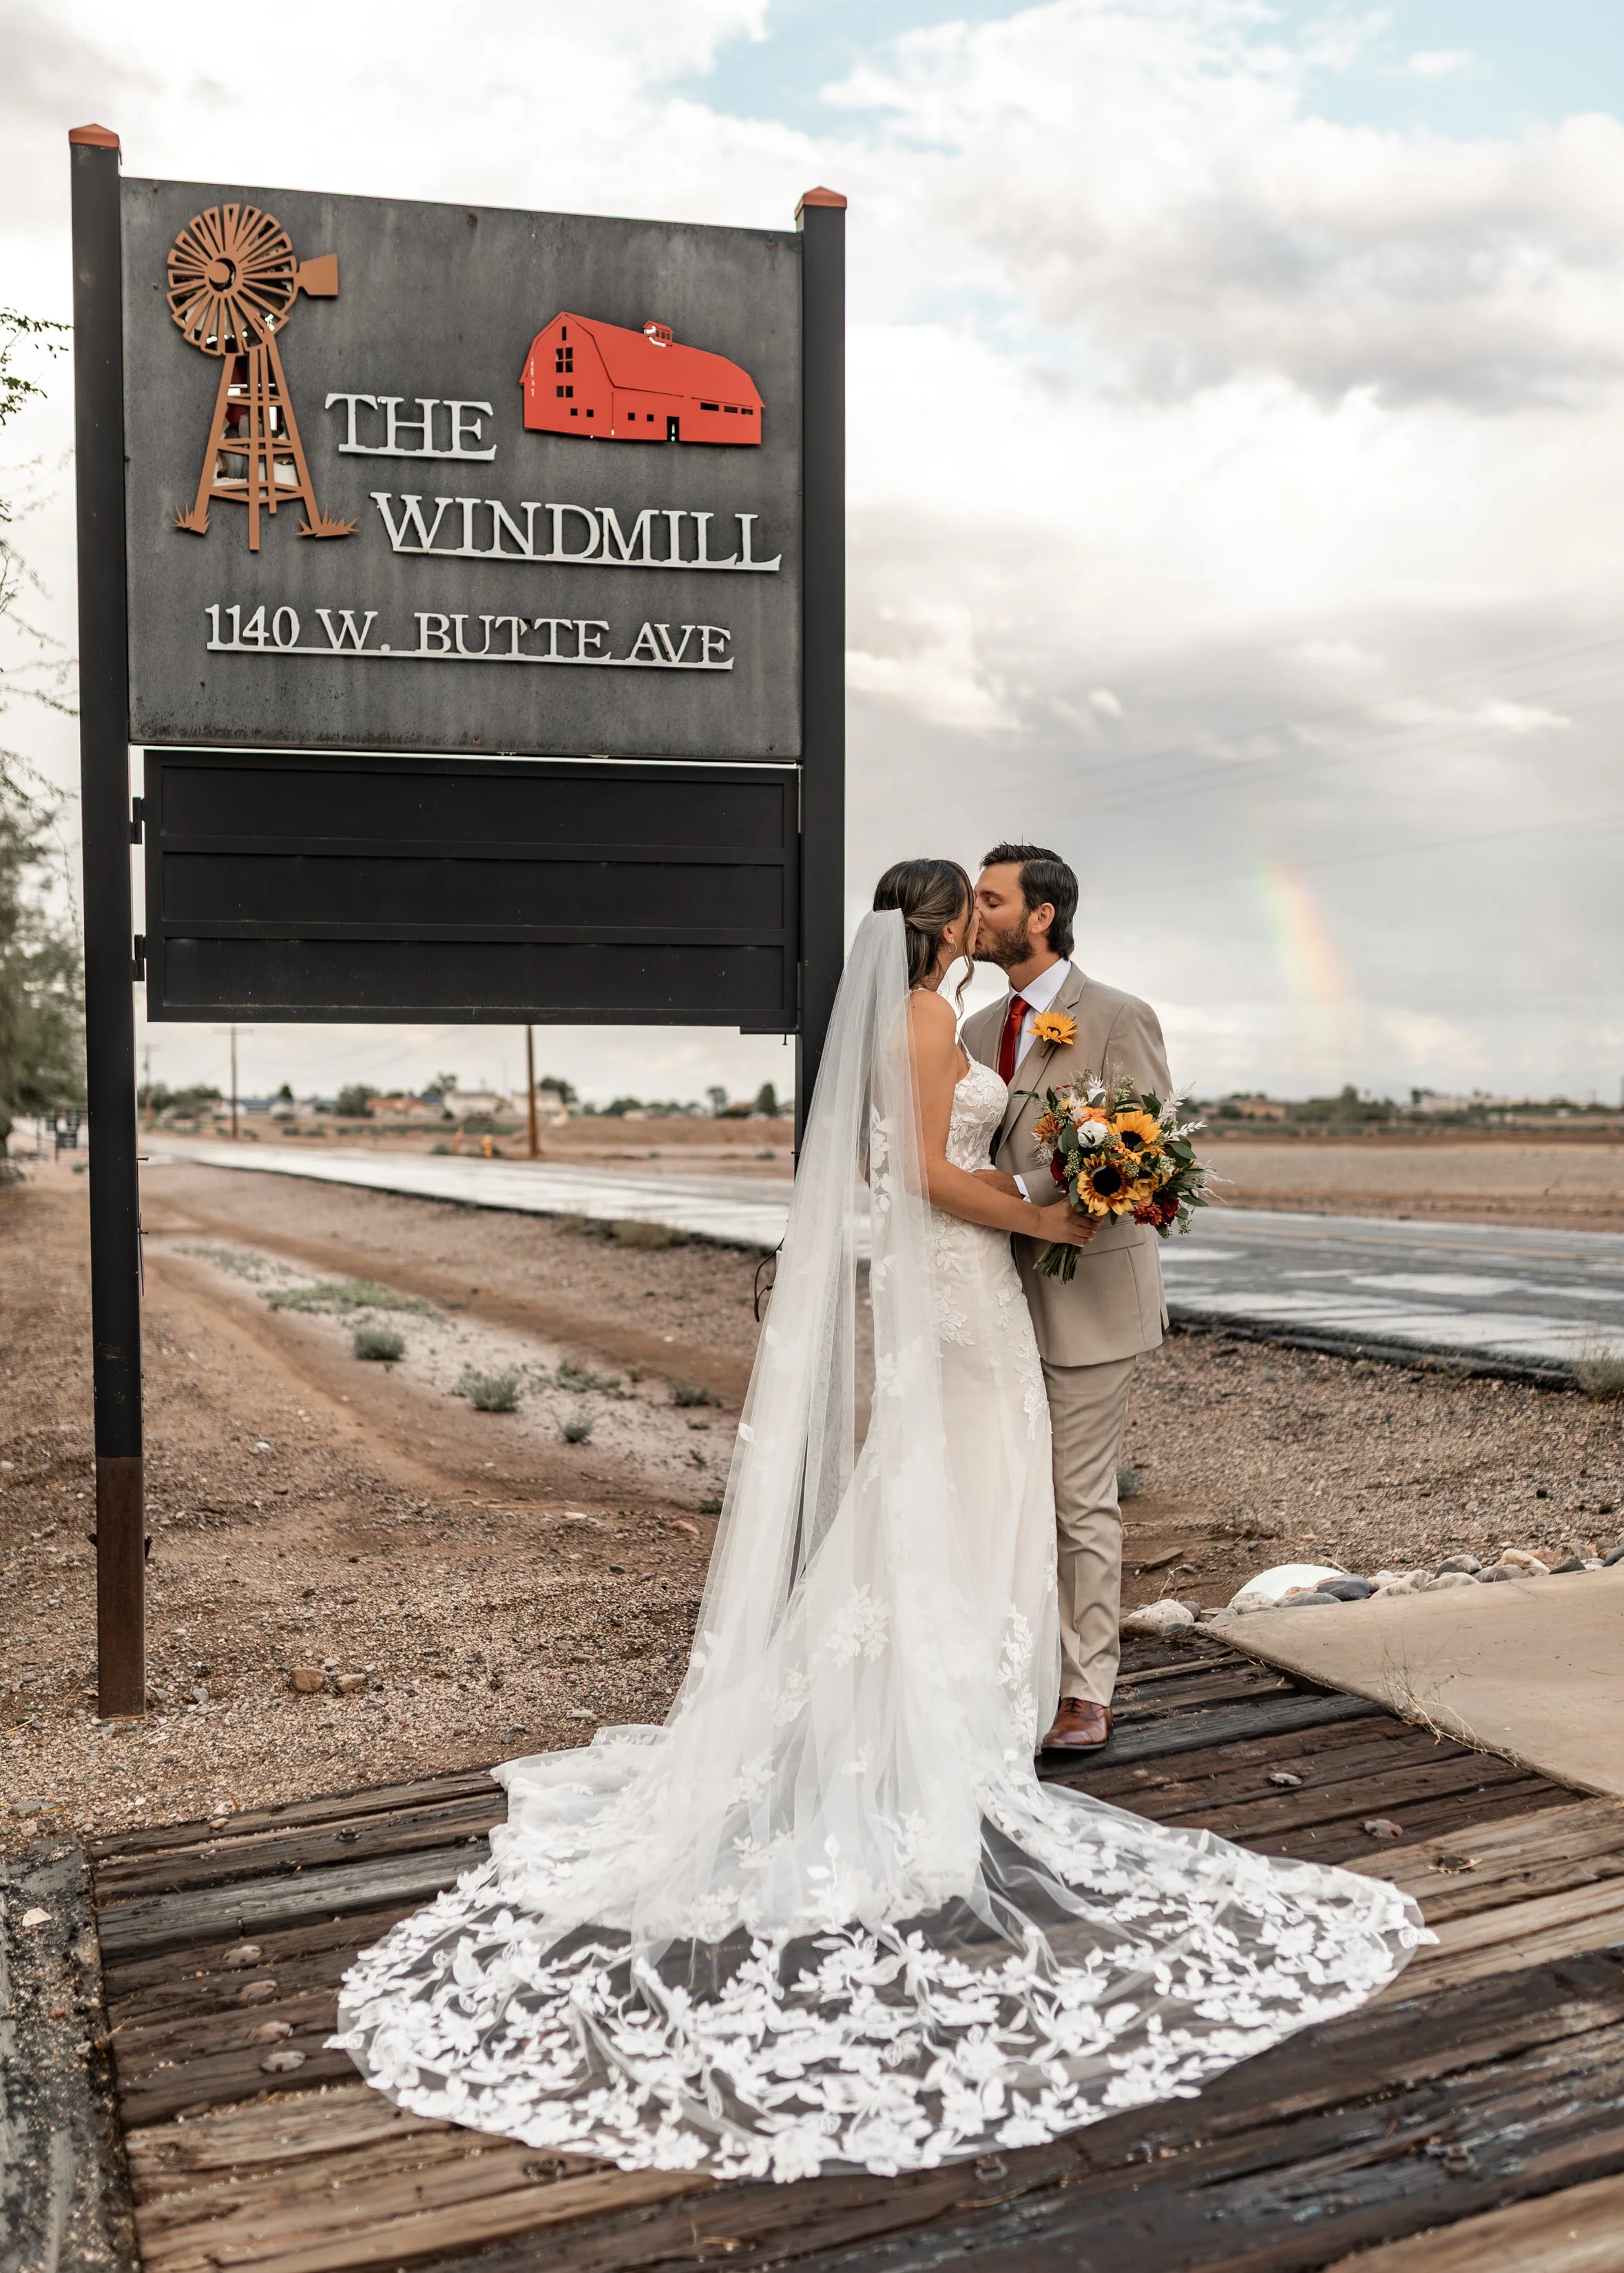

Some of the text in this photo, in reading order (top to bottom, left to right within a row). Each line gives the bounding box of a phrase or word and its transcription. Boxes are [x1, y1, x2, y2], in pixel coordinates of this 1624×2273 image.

[324, 392, 497, 461] THE
[370, 491, 782, 572] WINDMILL
[205, 603, 735, 669] 1140 W. BUTTE AVE
